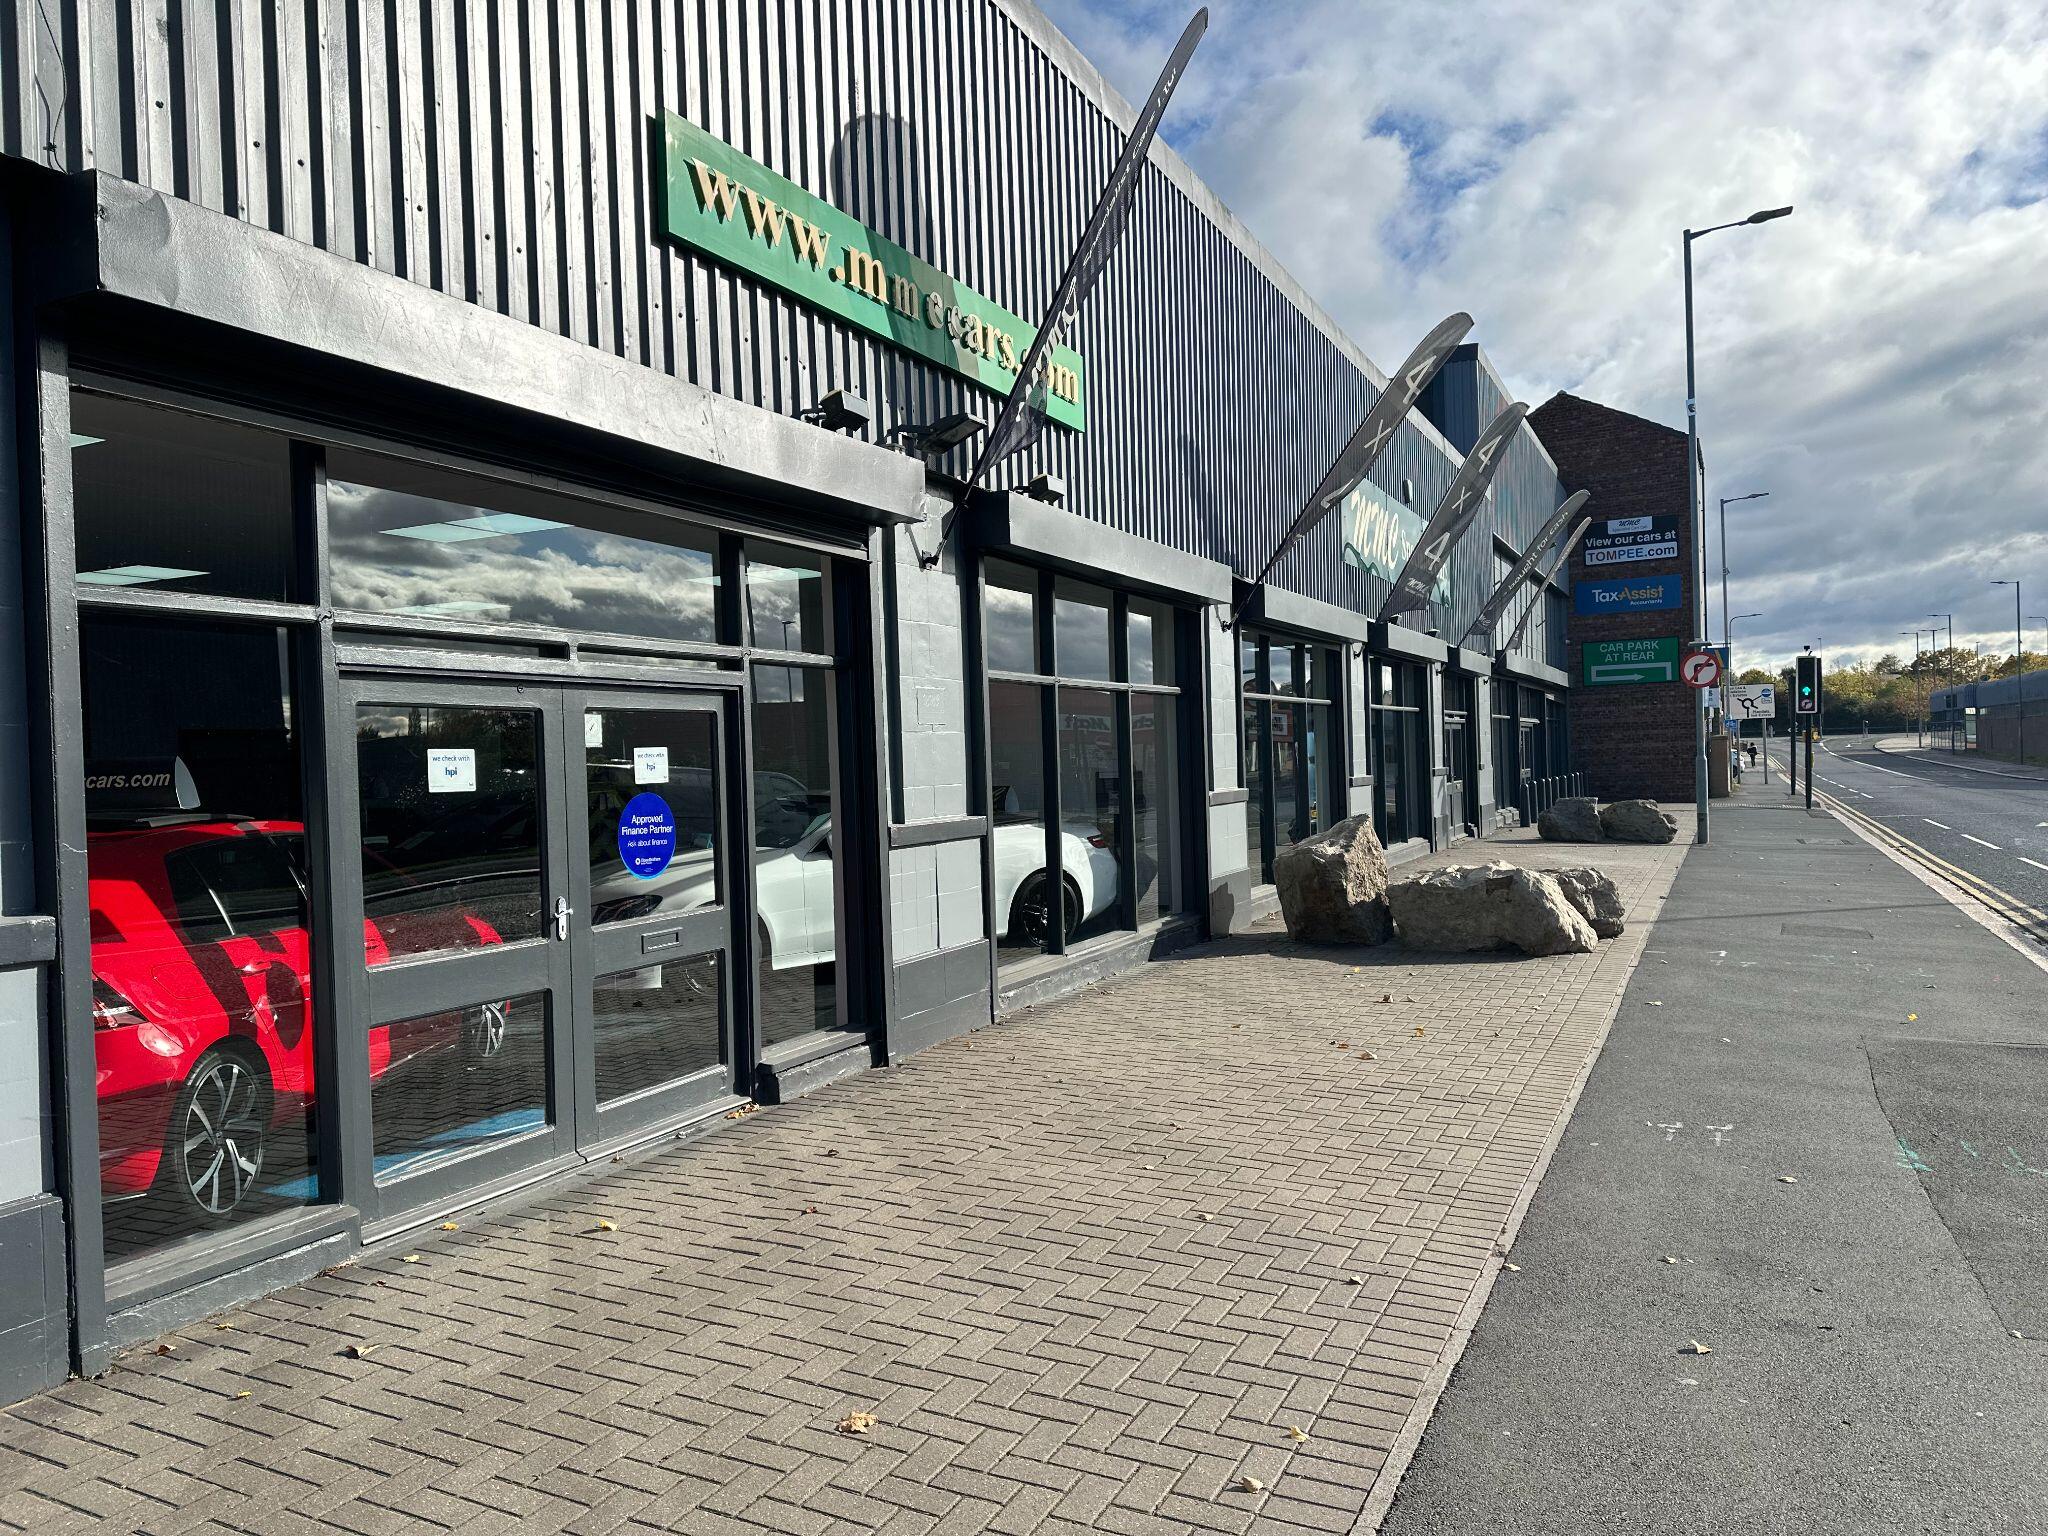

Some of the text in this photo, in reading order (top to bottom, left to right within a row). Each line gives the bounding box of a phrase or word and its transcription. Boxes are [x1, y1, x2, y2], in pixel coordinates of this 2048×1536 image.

[690, 157, 1080, 405] www.mmccars.om
[1549, 511, 1569, 536] cash
[1585, 529, 1676, 548] View our cars at
[1587, 546, 1675, 563] TOMPEE.com
[1592, 585, 1664, 603] TaxAssist
[1600, 640, 1660, 653] CAR PARK
[1604, 651, 1655, 663] AT REAR
[445, 767, 458, 778] hpi
[646, 763, 656, 772] hpi
[84, 773, 171, 789] cars.com
[631, 814, 664, 826] Approved
[621, 825, 674, 836] Finance Partner
